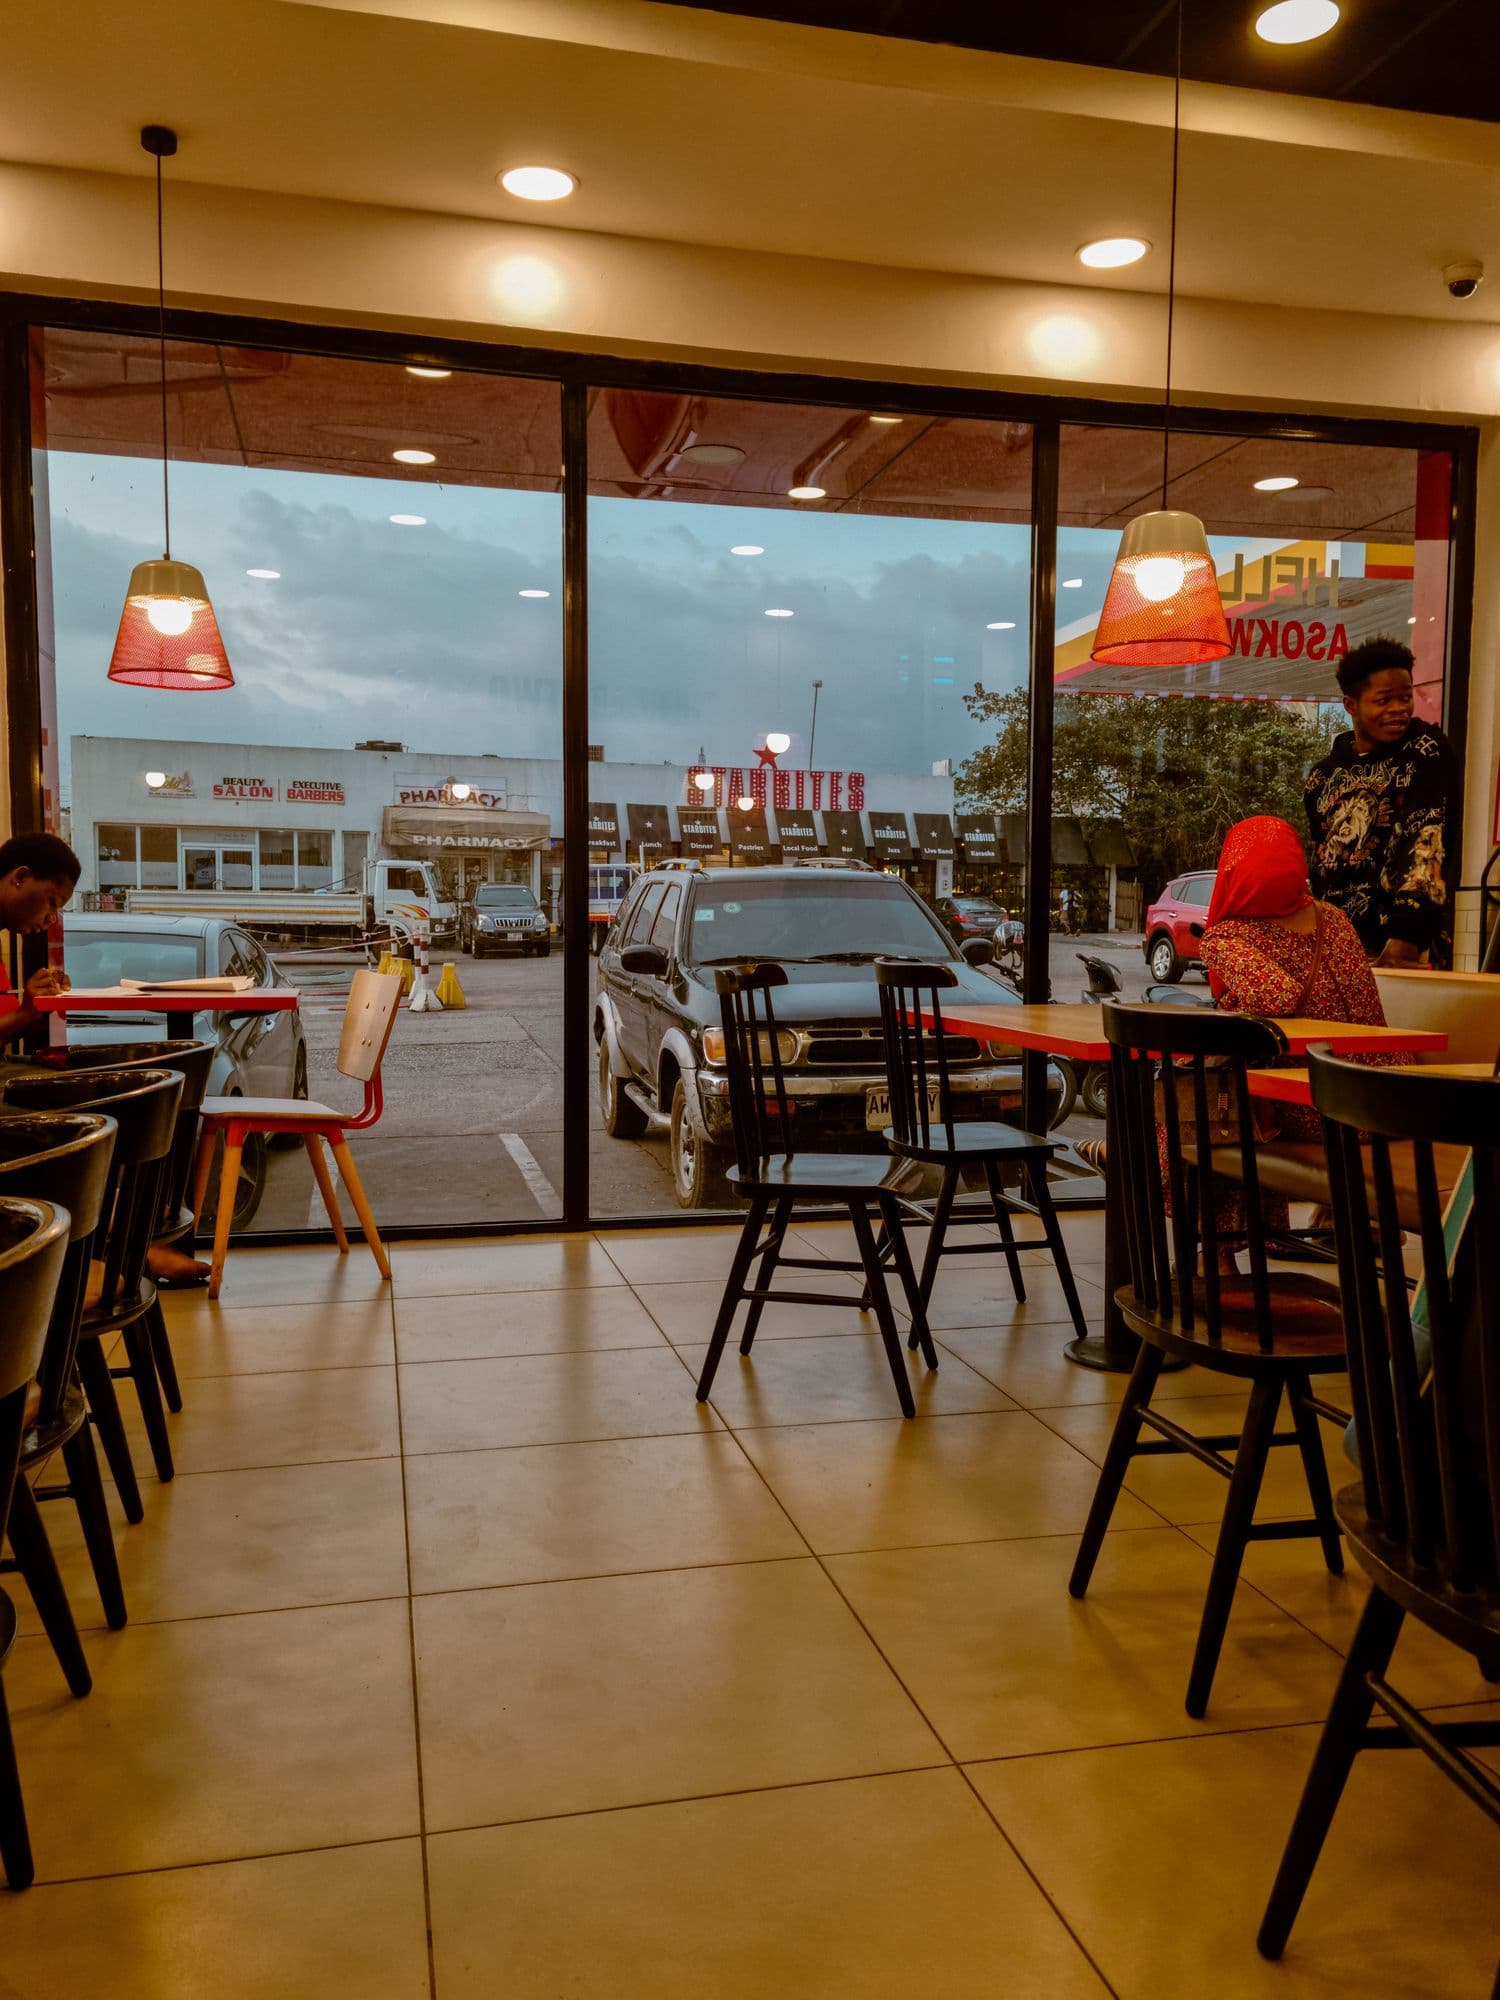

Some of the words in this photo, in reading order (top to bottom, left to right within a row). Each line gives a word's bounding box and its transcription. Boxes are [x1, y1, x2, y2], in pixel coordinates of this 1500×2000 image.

[222, 777, 265, 787] BEAUTY
[292, 780, 343, 791] EXECUTIVE
[213, 784, 273, 799] SALON
[687, 766, 865, 811] STARBITES
[286, 788, 345, 802] BARBERS
[400, 788, 502, 808] PHARACY
[682, 824, 717, 834] STARBITES
[780, 827, 814, 837] STARBITES
[412, 835, 531, 849] PHARMACY
[588, 840, 616, 848] reakfast
[641, 841, 662, 849] Lunch
[690, 842, 714, 850] Dinner
[738, 843, 764, 851] Pastries
[782, 844, 800, 852] Local
[801, 844, 818, 852] Food
[841, 845, 854, 853] Bar
